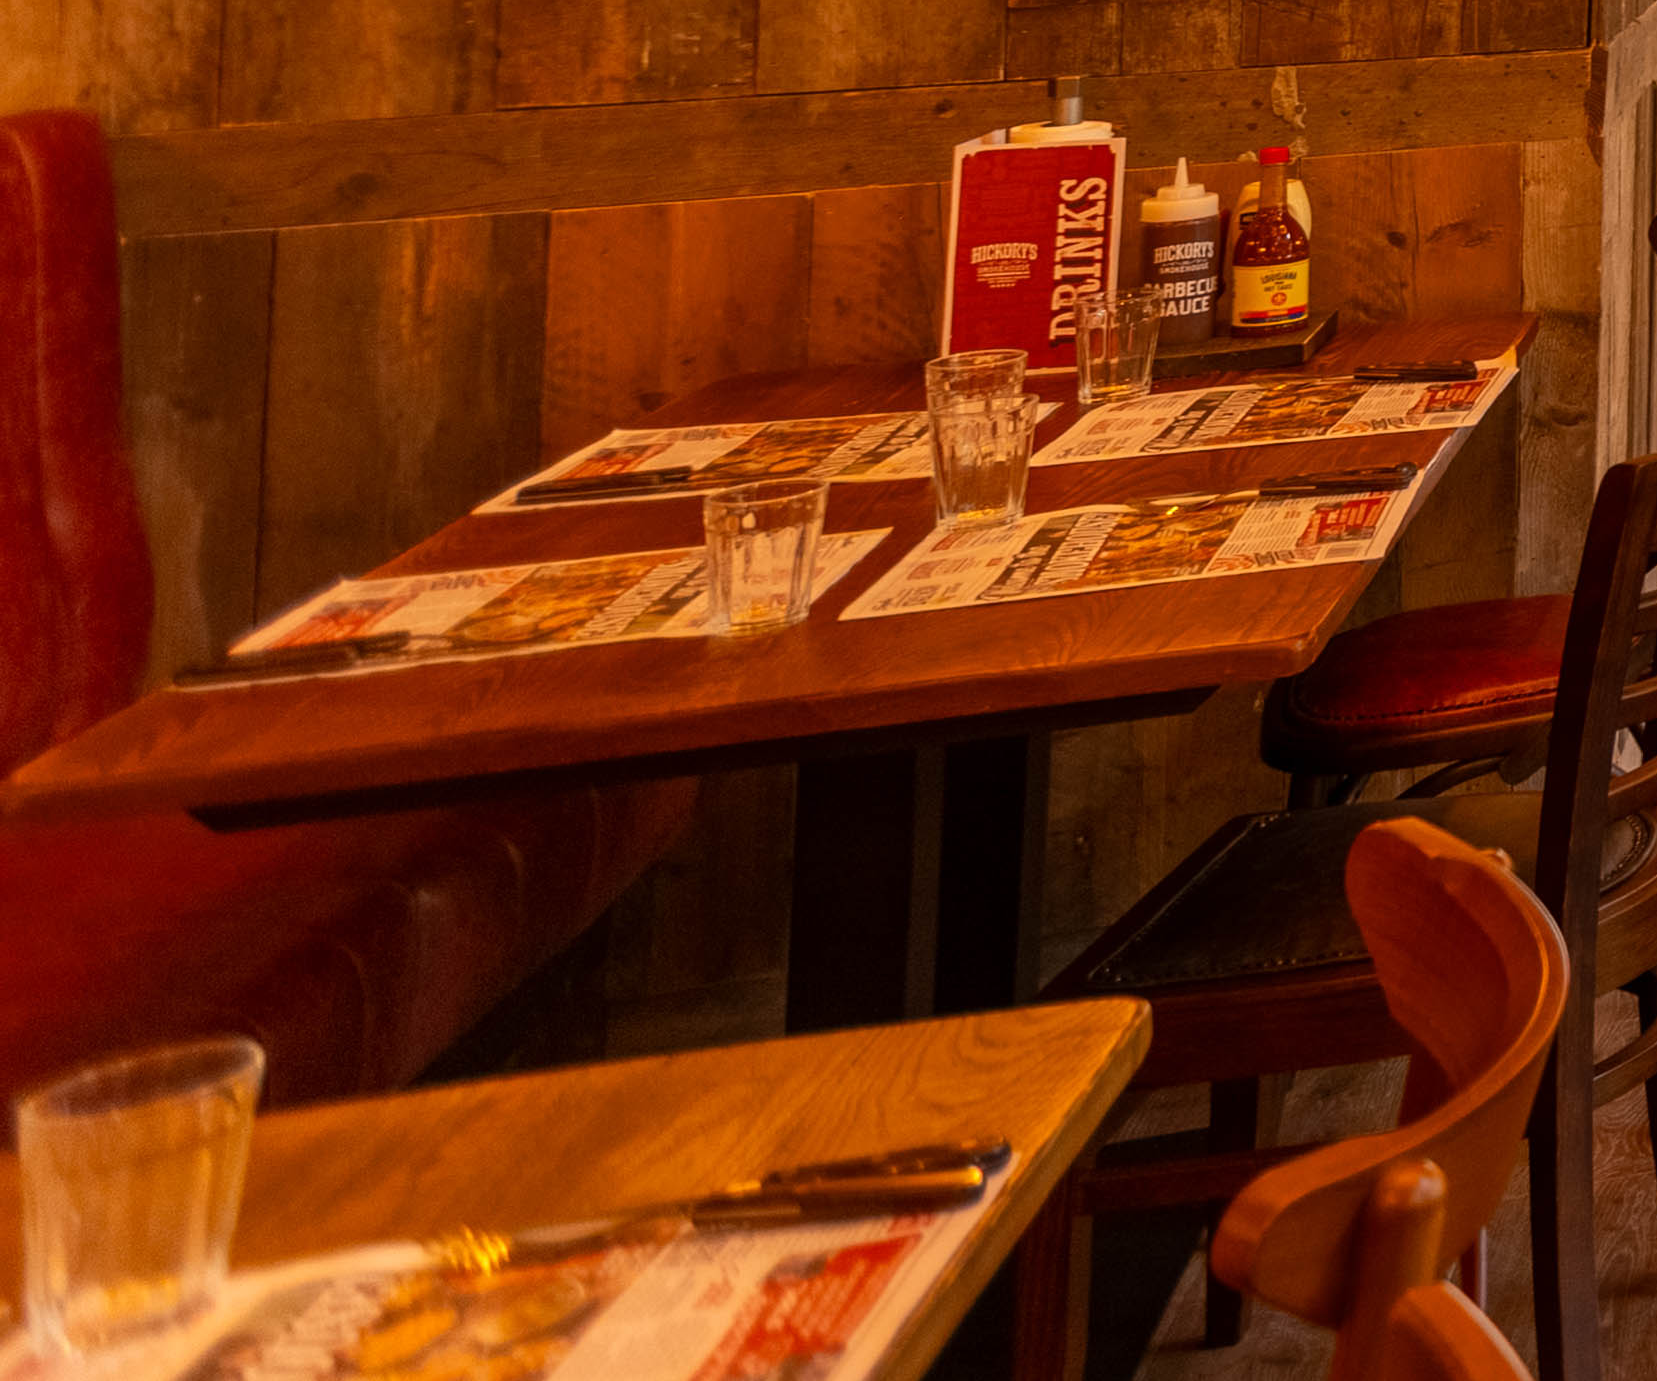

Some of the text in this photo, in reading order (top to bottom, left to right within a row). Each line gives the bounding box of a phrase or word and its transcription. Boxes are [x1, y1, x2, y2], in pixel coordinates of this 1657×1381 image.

[970, 243, 1038, 264] HICKORY'S
[1049, 178, 1108, 340] DRINKS
[1153, 241, 1215, 264] HICKORY'S
